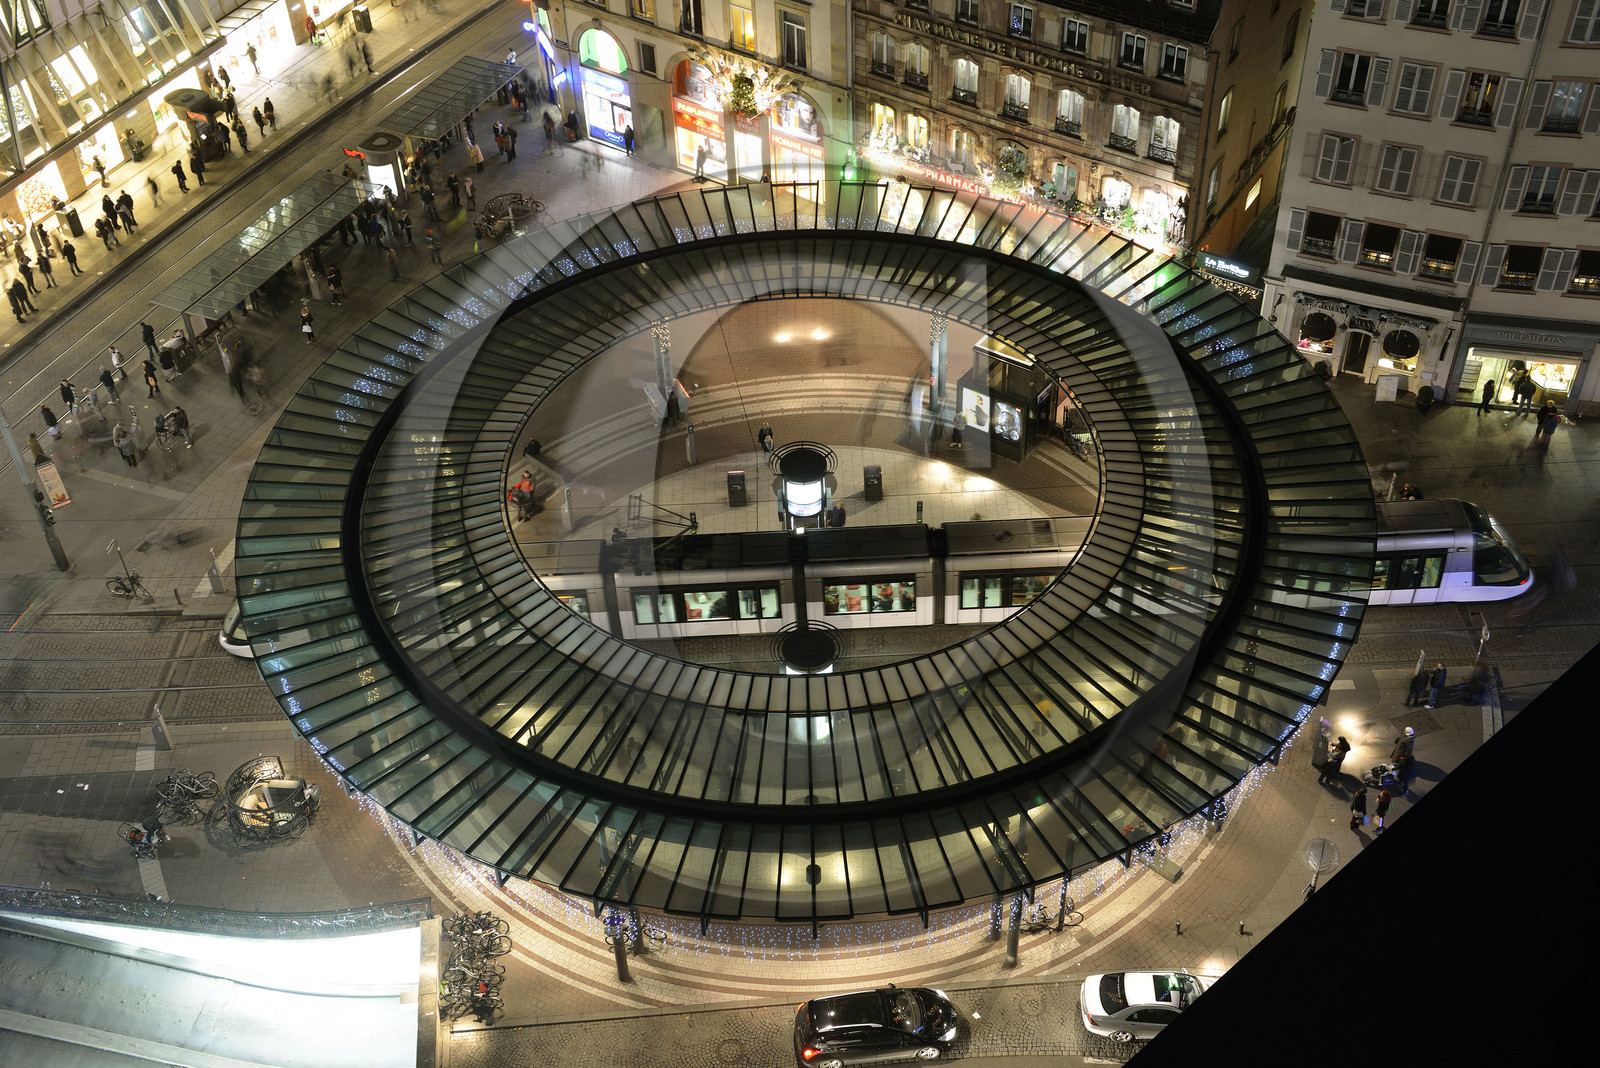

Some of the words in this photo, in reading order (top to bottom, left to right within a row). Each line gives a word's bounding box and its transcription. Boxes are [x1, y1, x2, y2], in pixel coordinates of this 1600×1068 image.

[893, 12, 979, 47] PHARMACIE
[984, 39, 1006, 56] DE
[677, 102, 720, 123] PARFUMERIE
[771, 134, 802, 151] HOMME
[925, 169, 986, 194] PHARMACIE
